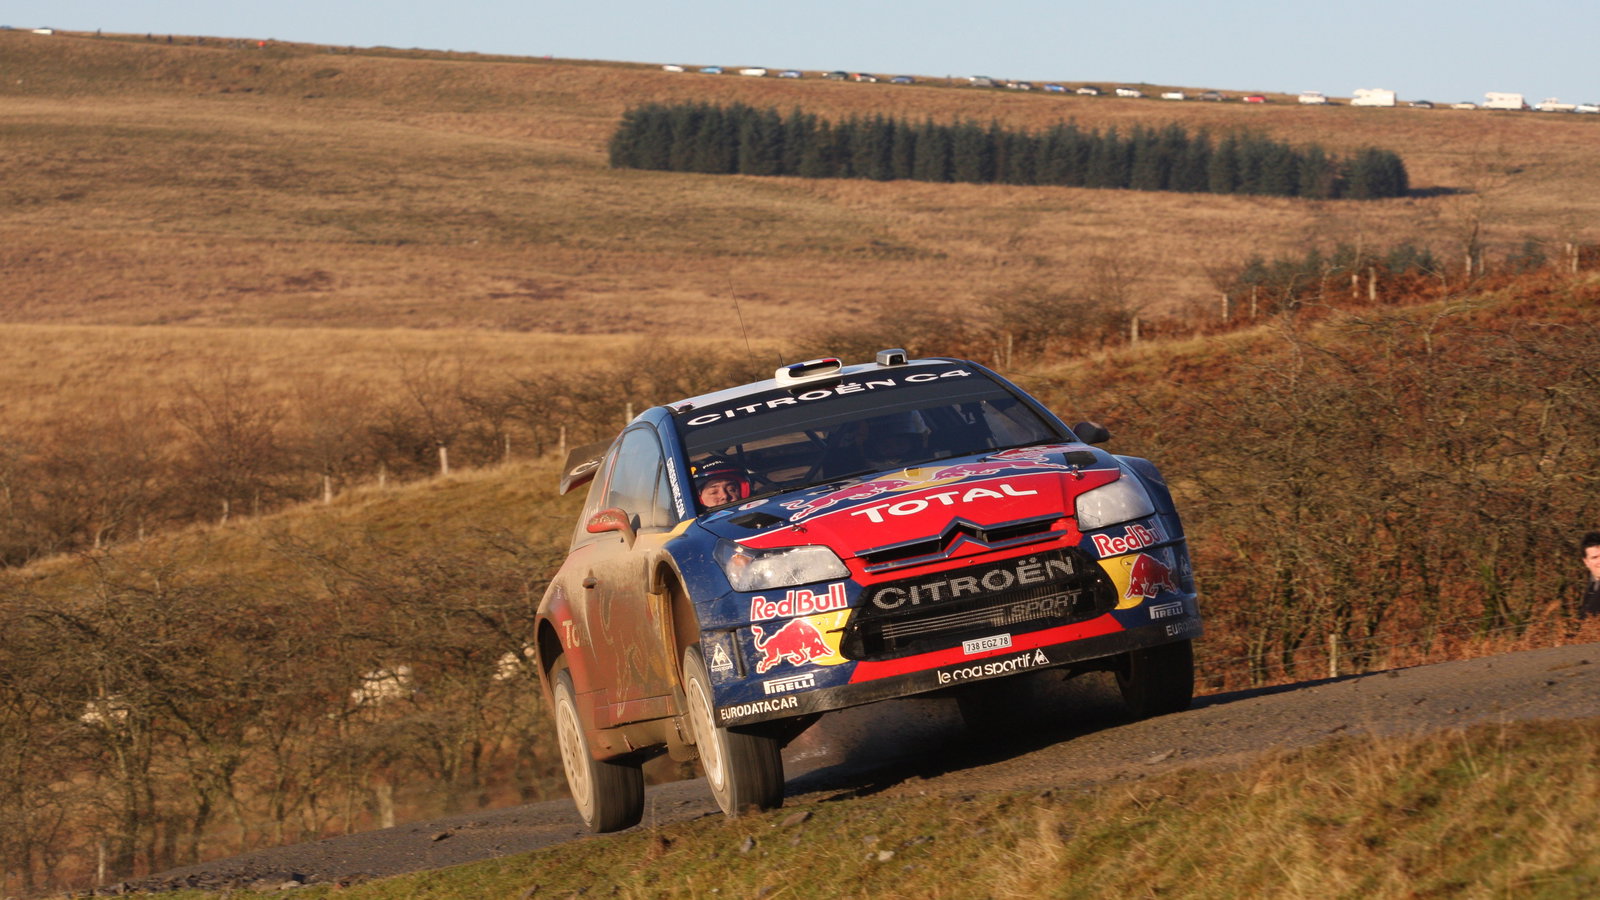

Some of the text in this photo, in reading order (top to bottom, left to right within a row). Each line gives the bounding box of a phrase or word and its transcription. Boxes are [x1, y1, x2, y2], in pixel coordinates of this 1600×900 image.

[687, 369, 972, 426] CITROËN C4
[851, 483, 1038, 524] TOTAL
[872, 556, 1075, 610] CITROËN
[1011, 592, 1081, 618] SPORT
[1149, 601, 1184, 620] PIRELLI
[966, 636, 1009, 652] 738 EGZ 78
[937, 670, 951, 684] le
[984, 653, 1031, 675] sportif
[763, 673, 815, 695] PIRELLI
[720, 696, 798, 720] EURODATACAR
